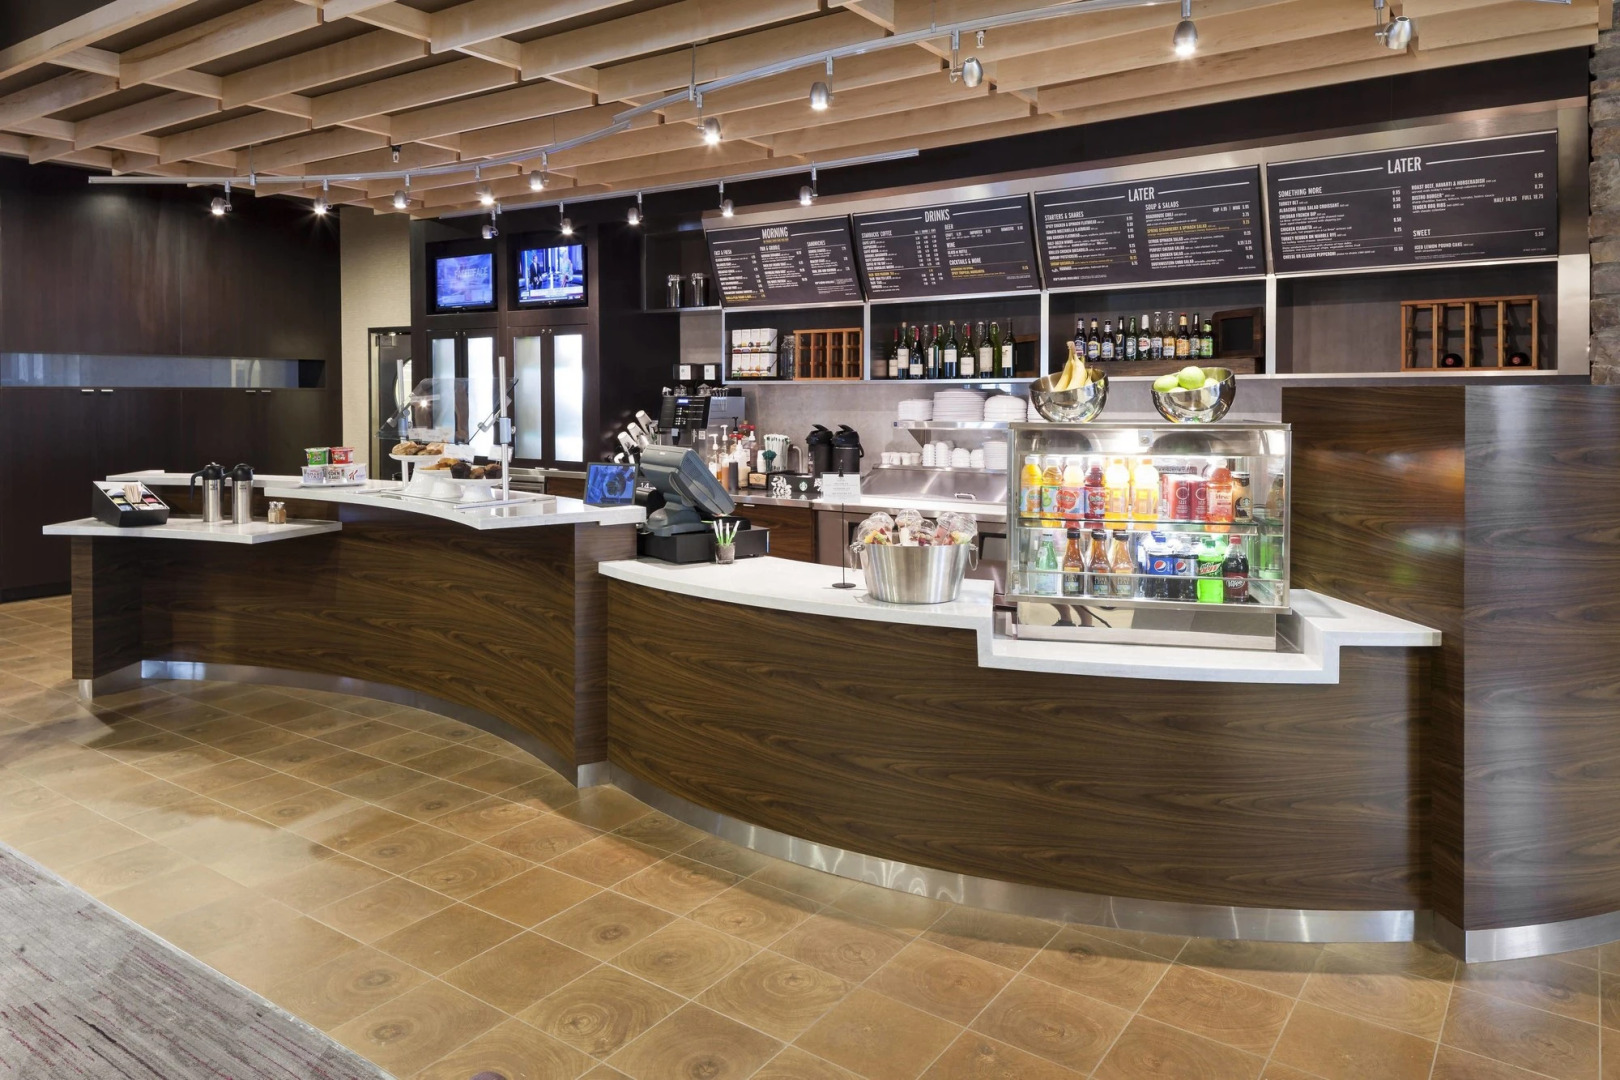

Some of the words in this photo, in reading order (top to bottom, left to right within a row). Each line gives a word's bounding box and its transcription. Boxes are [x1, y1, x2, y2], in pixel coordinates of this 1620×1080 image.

[1388, 156, 1422, 174] LATER
[1128, 187, 1154, 202] LATER
[1278, 188, 1306, 198] SOMETHING
[924, 209, 950, 222] DRINKS
[762, 227, 788, 239] MORNING
